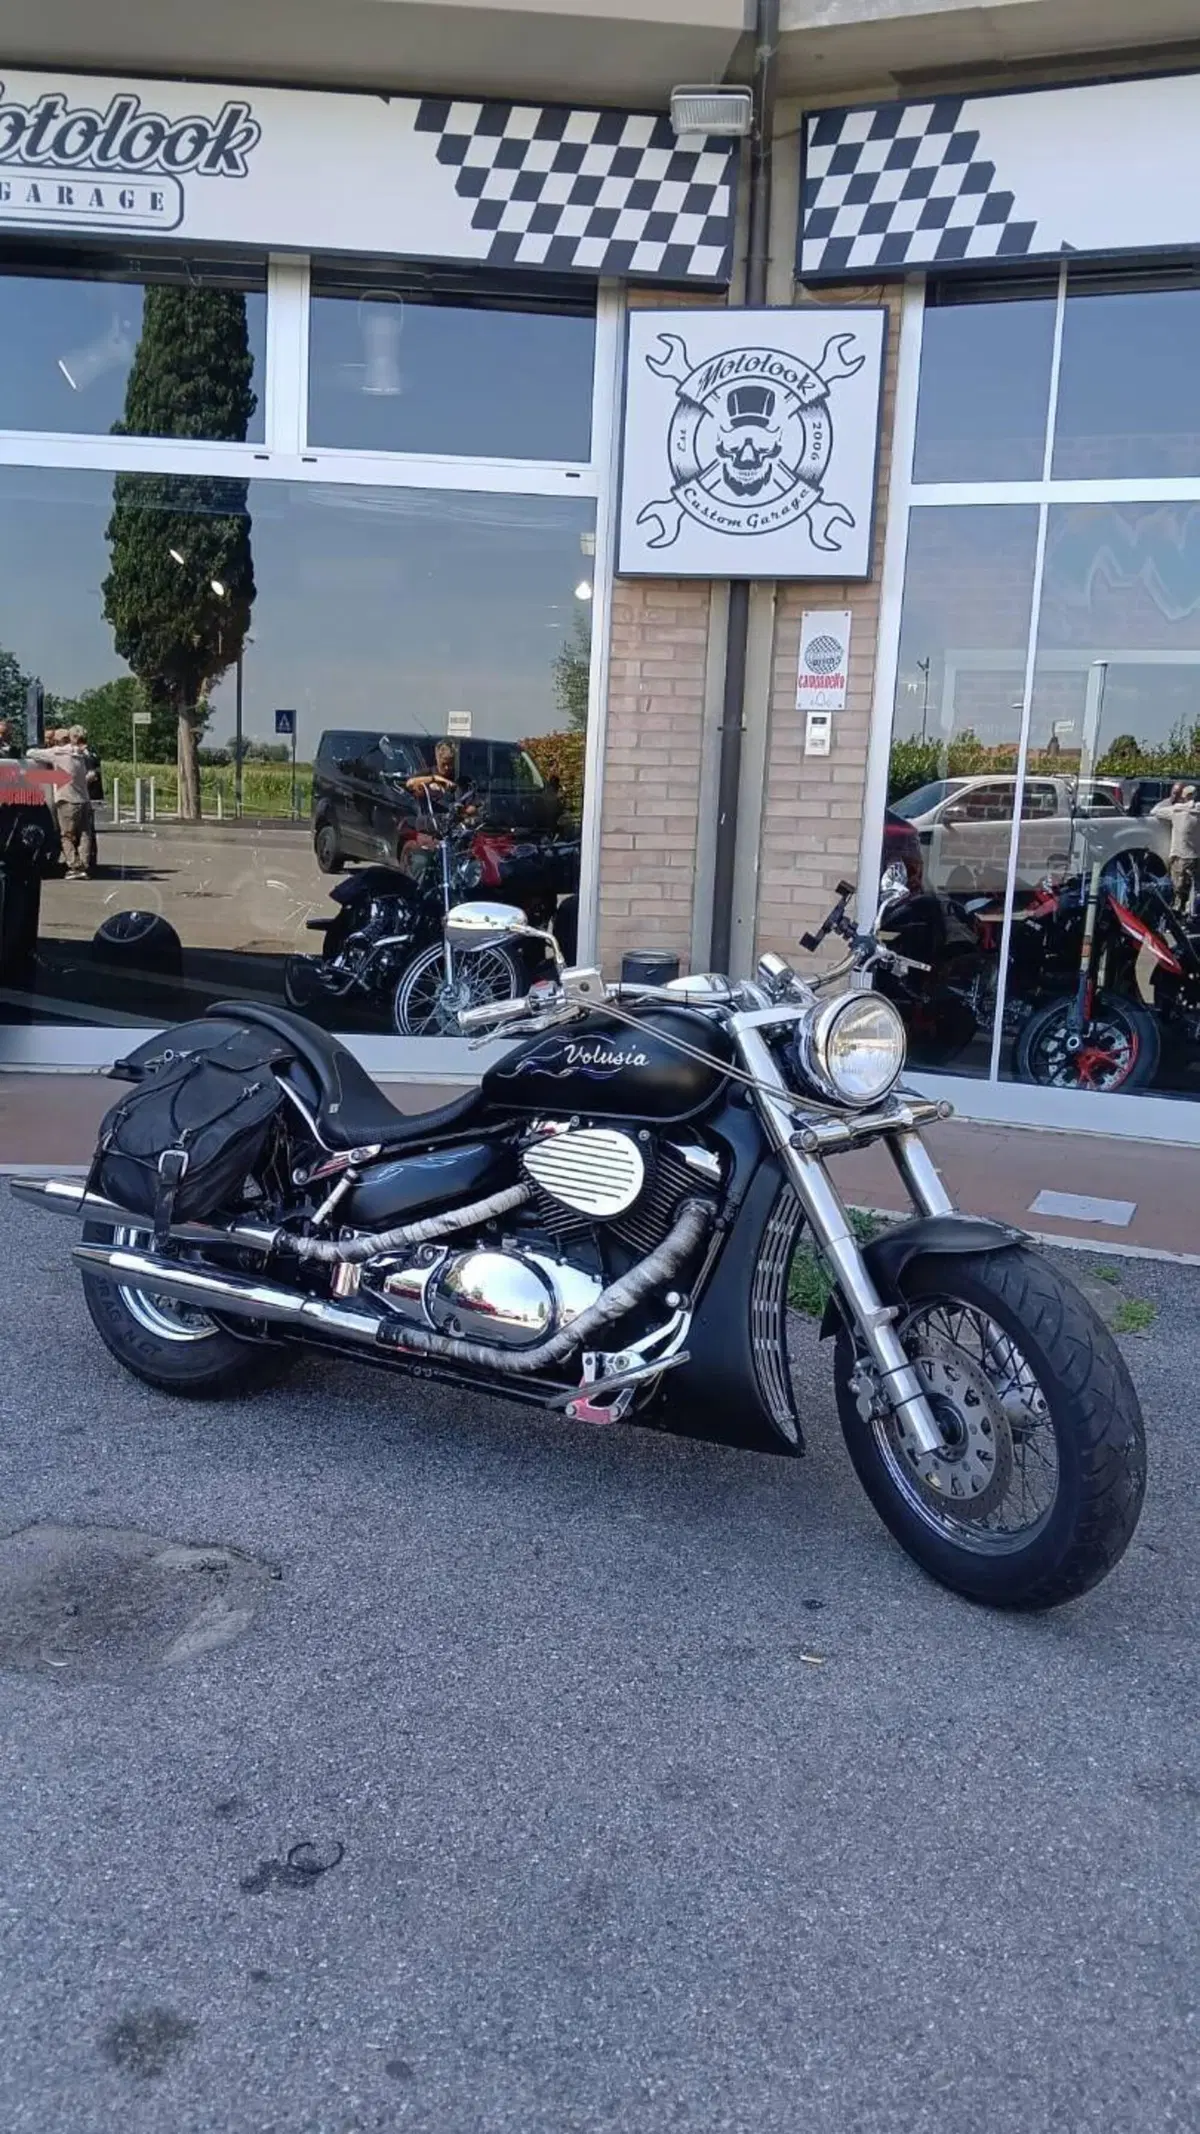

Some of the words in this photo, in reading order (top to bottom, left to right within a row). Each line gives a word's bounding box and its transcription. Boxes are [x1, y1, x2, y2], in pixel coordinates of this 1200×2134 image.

[0, 93, 261, 177] otolook
[0, 181, 165, 211] GARAGE
[696, 353, 816, 397] Motolook
[811, 422, 823, 461] 2006
[684, 488, 742, 527] Custom
[746, 489, 809, 528] Garage
[563, 1043, 649, 1066] Volusia
